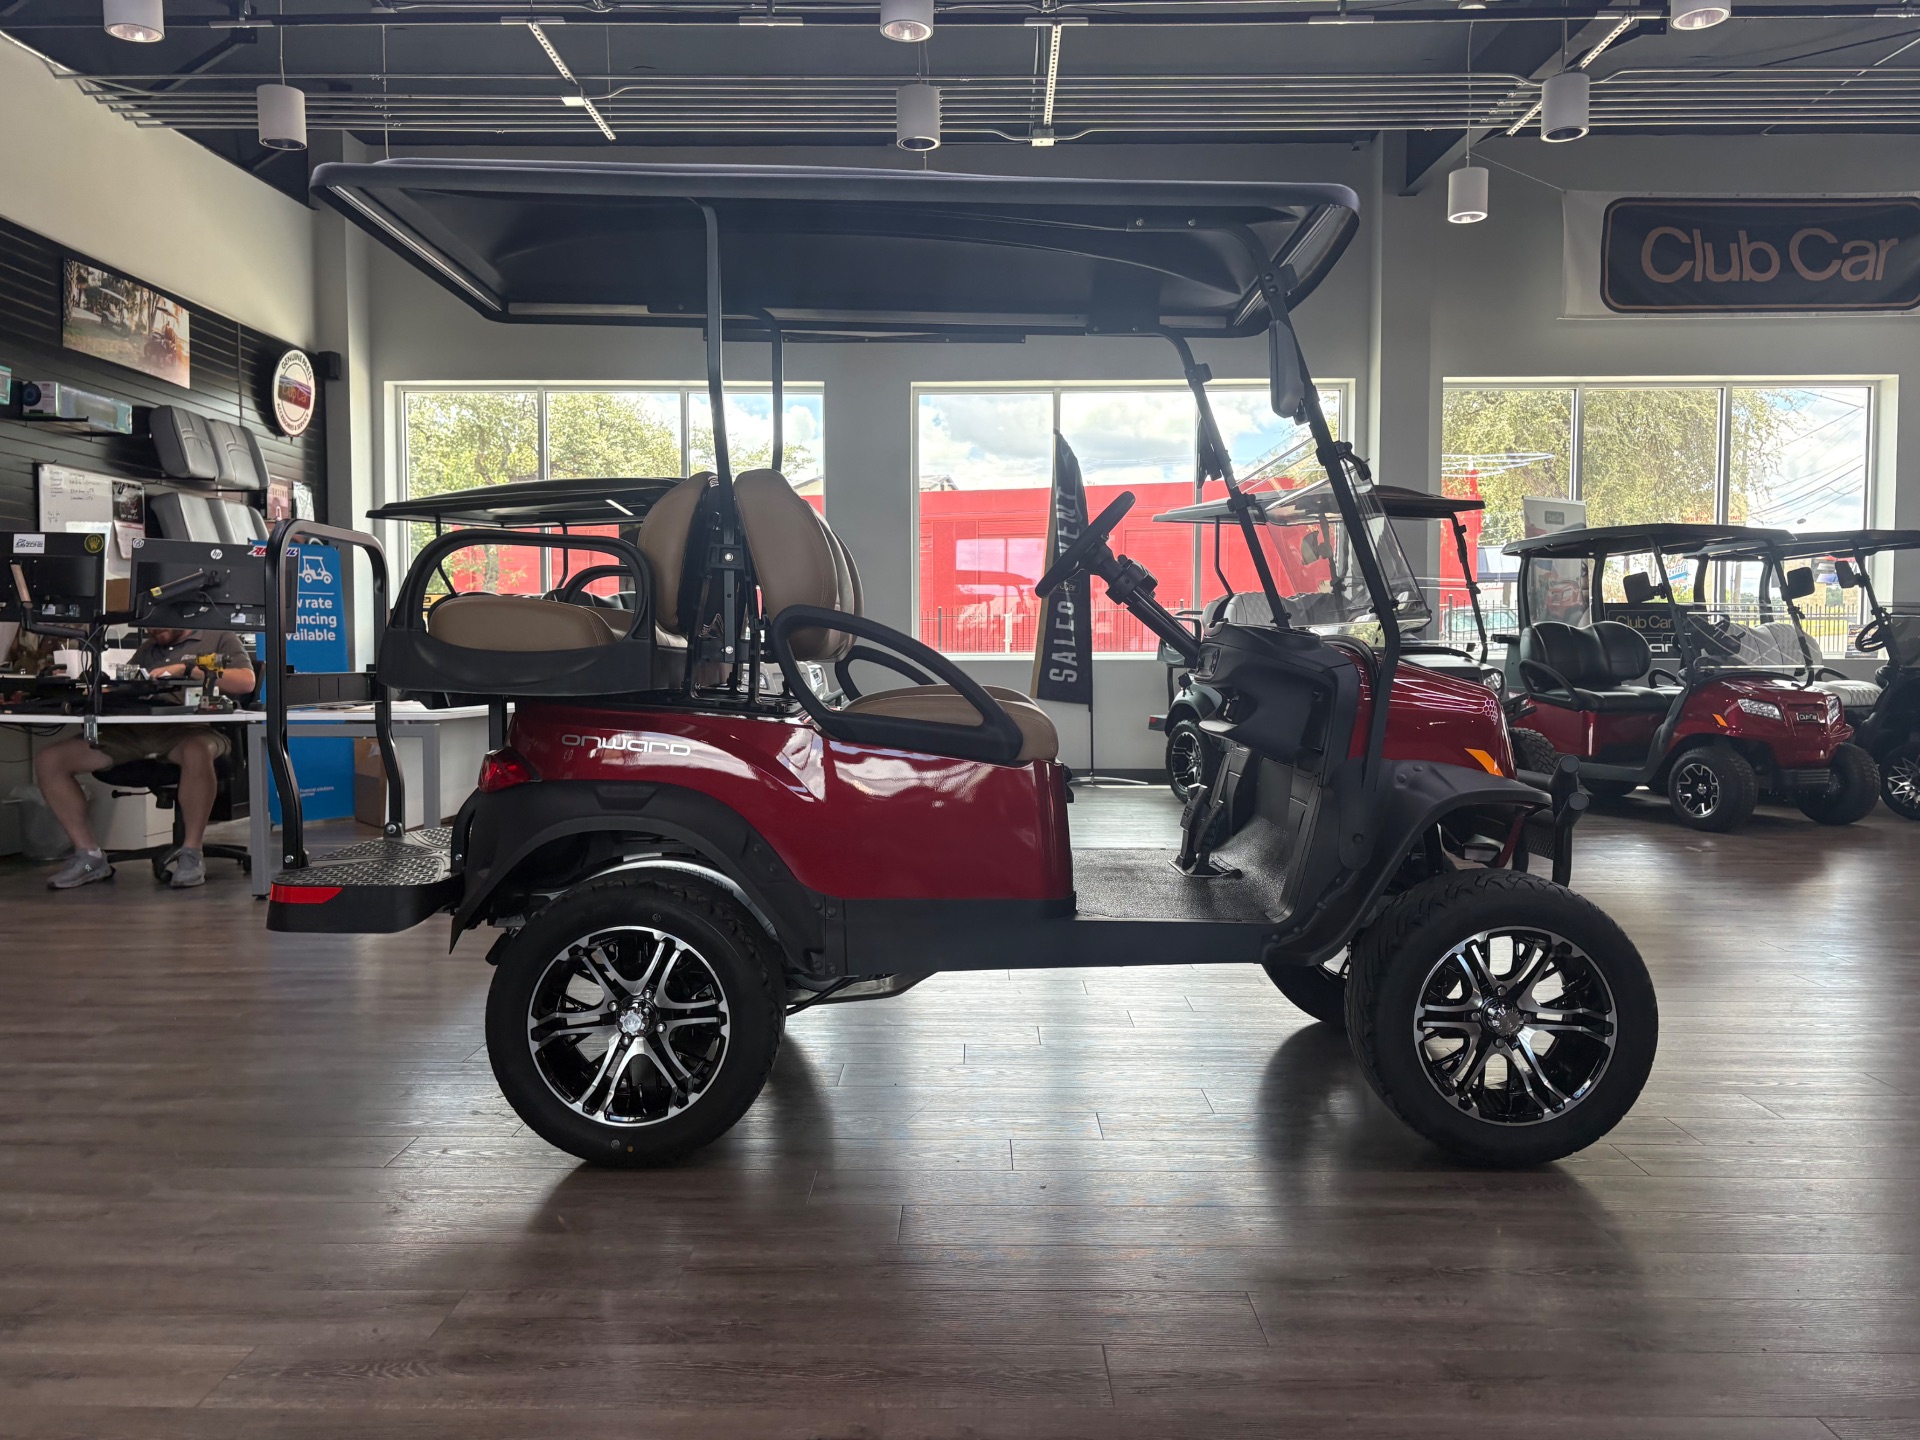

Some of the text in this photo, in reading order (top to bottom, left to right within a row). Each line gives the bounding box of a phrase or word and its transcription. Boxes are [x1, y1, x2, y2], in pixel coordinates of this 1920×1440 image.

[1641, 226, 1899, 284] Club Car
[305, 597, 332, 608] rate
[296, 612, 337, 628] ancing
[1648, 615, 1673, 629] Car
[286, 629, 336, 641] vailable
